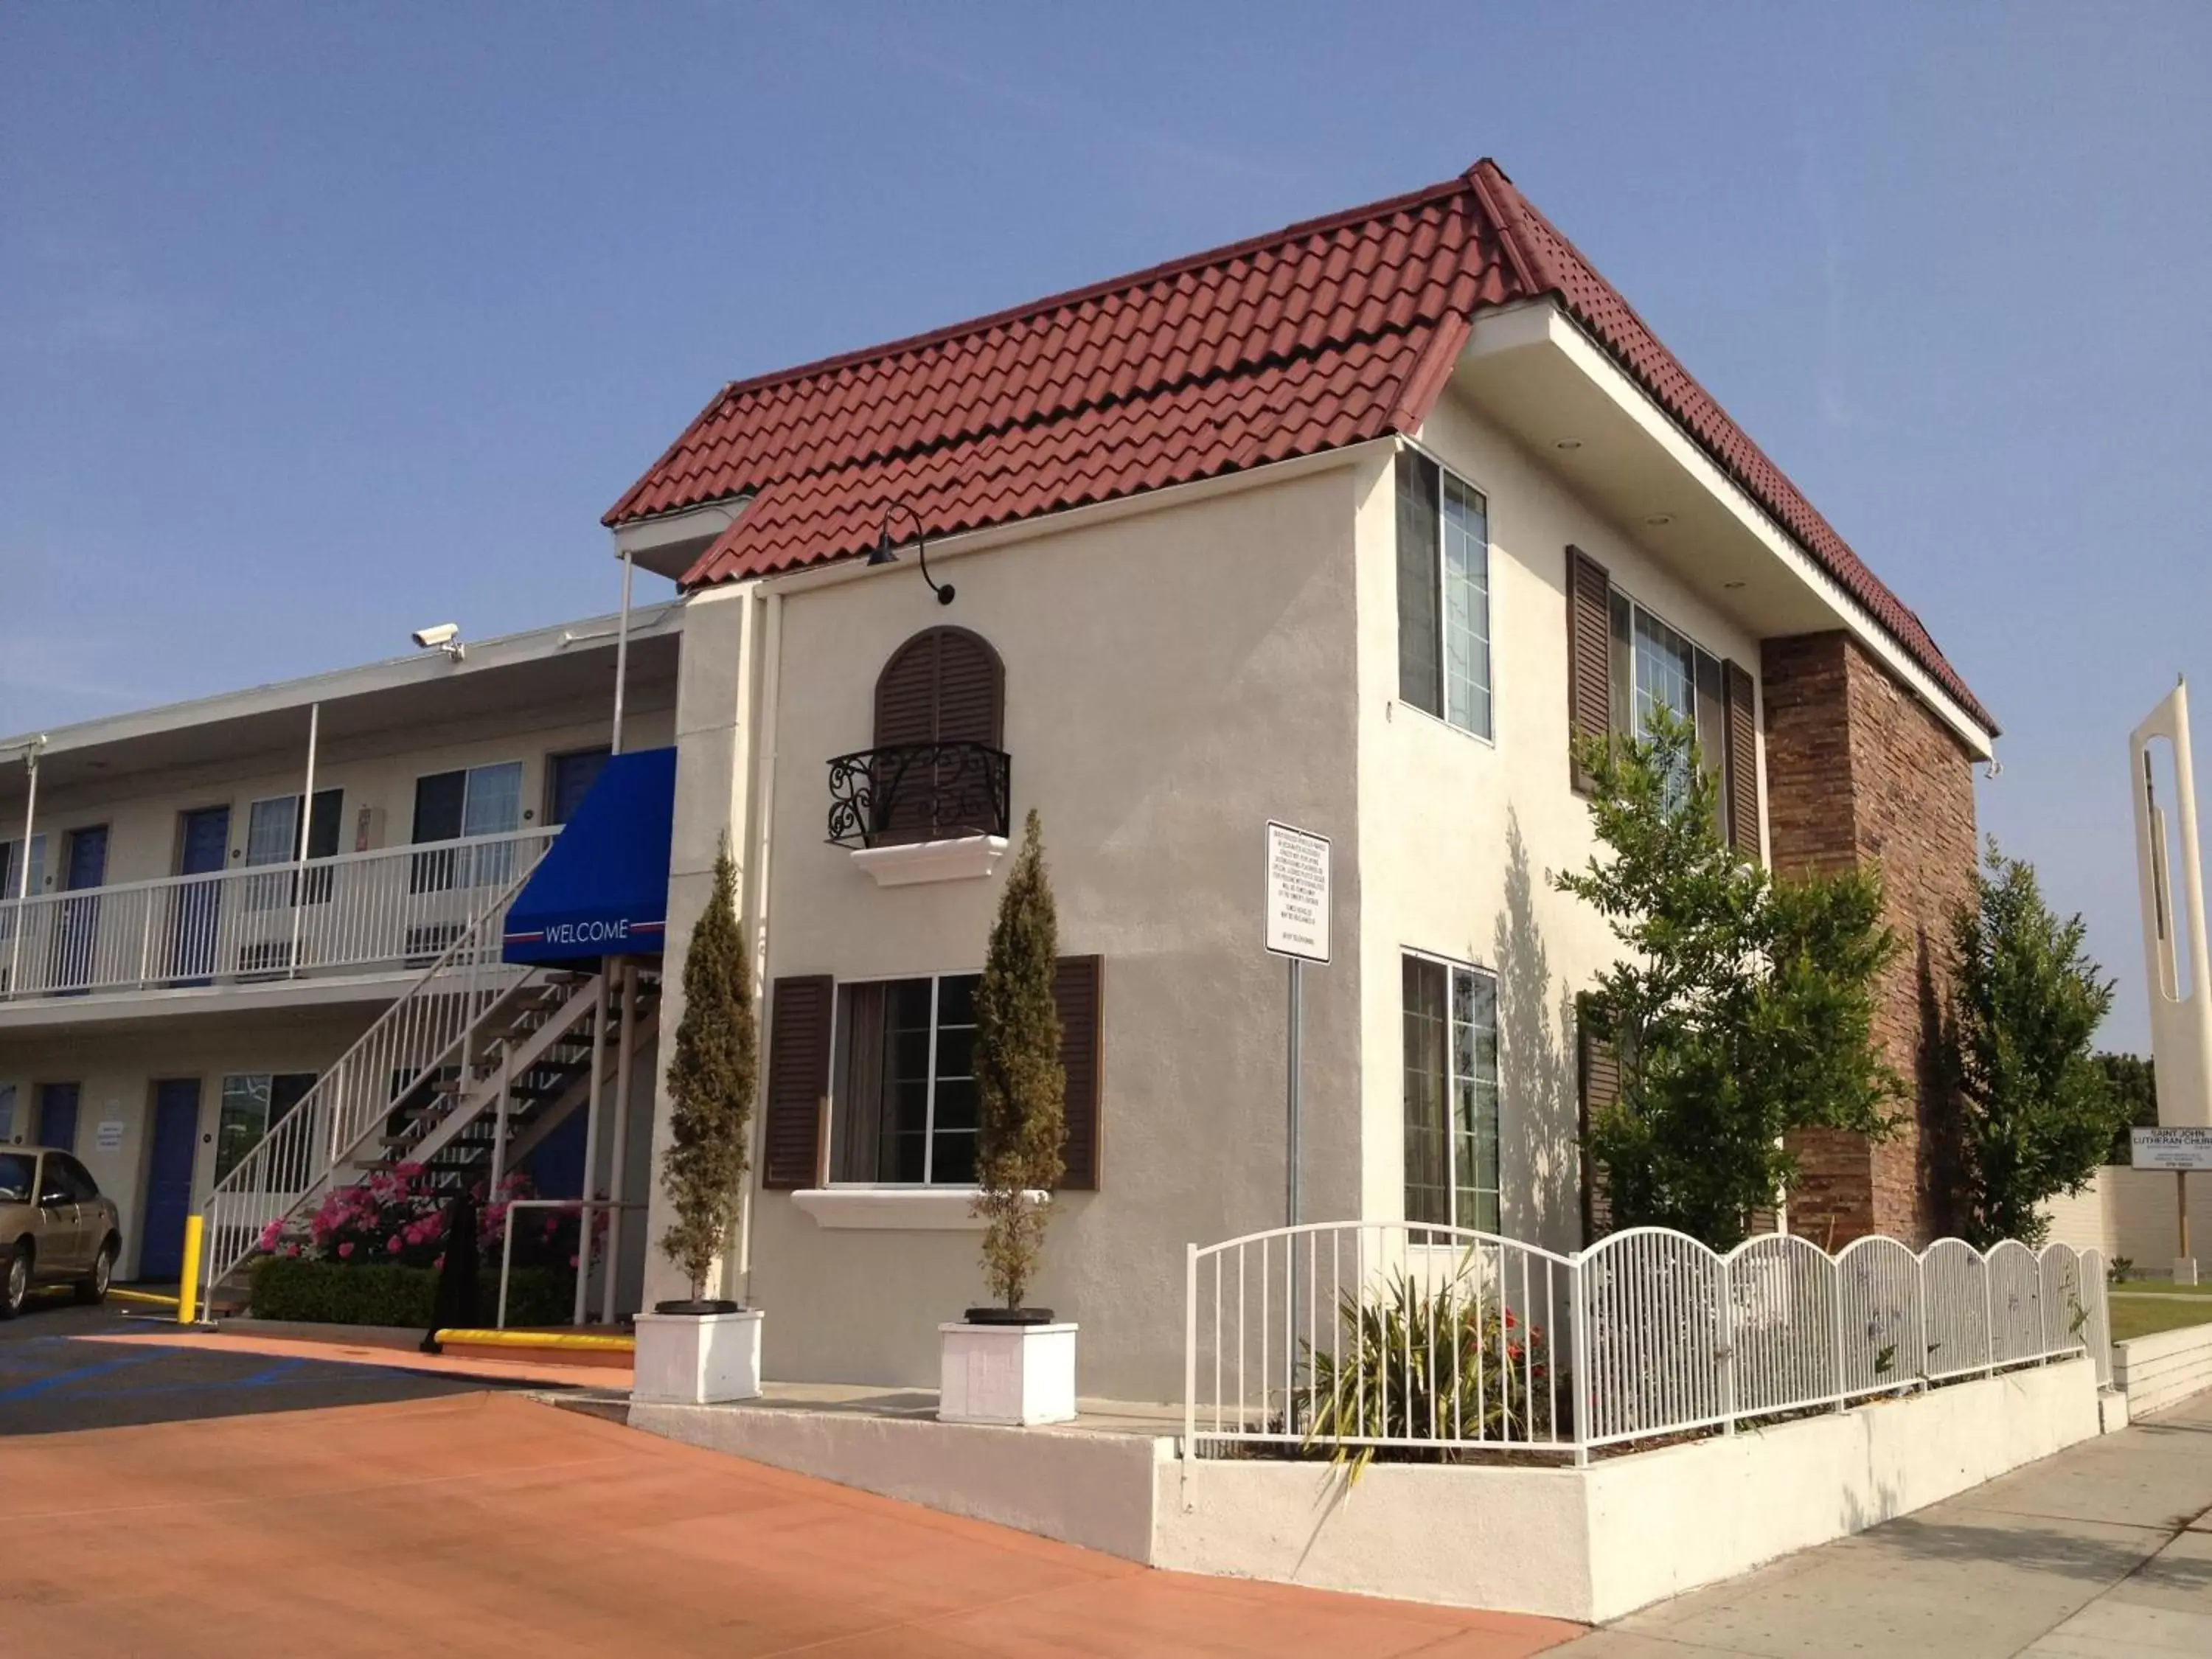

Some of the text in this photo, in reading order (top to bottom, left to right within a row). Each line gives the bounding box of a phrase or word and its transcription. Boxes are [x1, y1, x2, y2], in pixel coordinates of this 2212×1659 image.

[545, 918, 629, 944] WELCOME
[2151, 1129, 2177, 1137] SAINT
[2133, 1137, 2182, 1145] LUTHERAN
